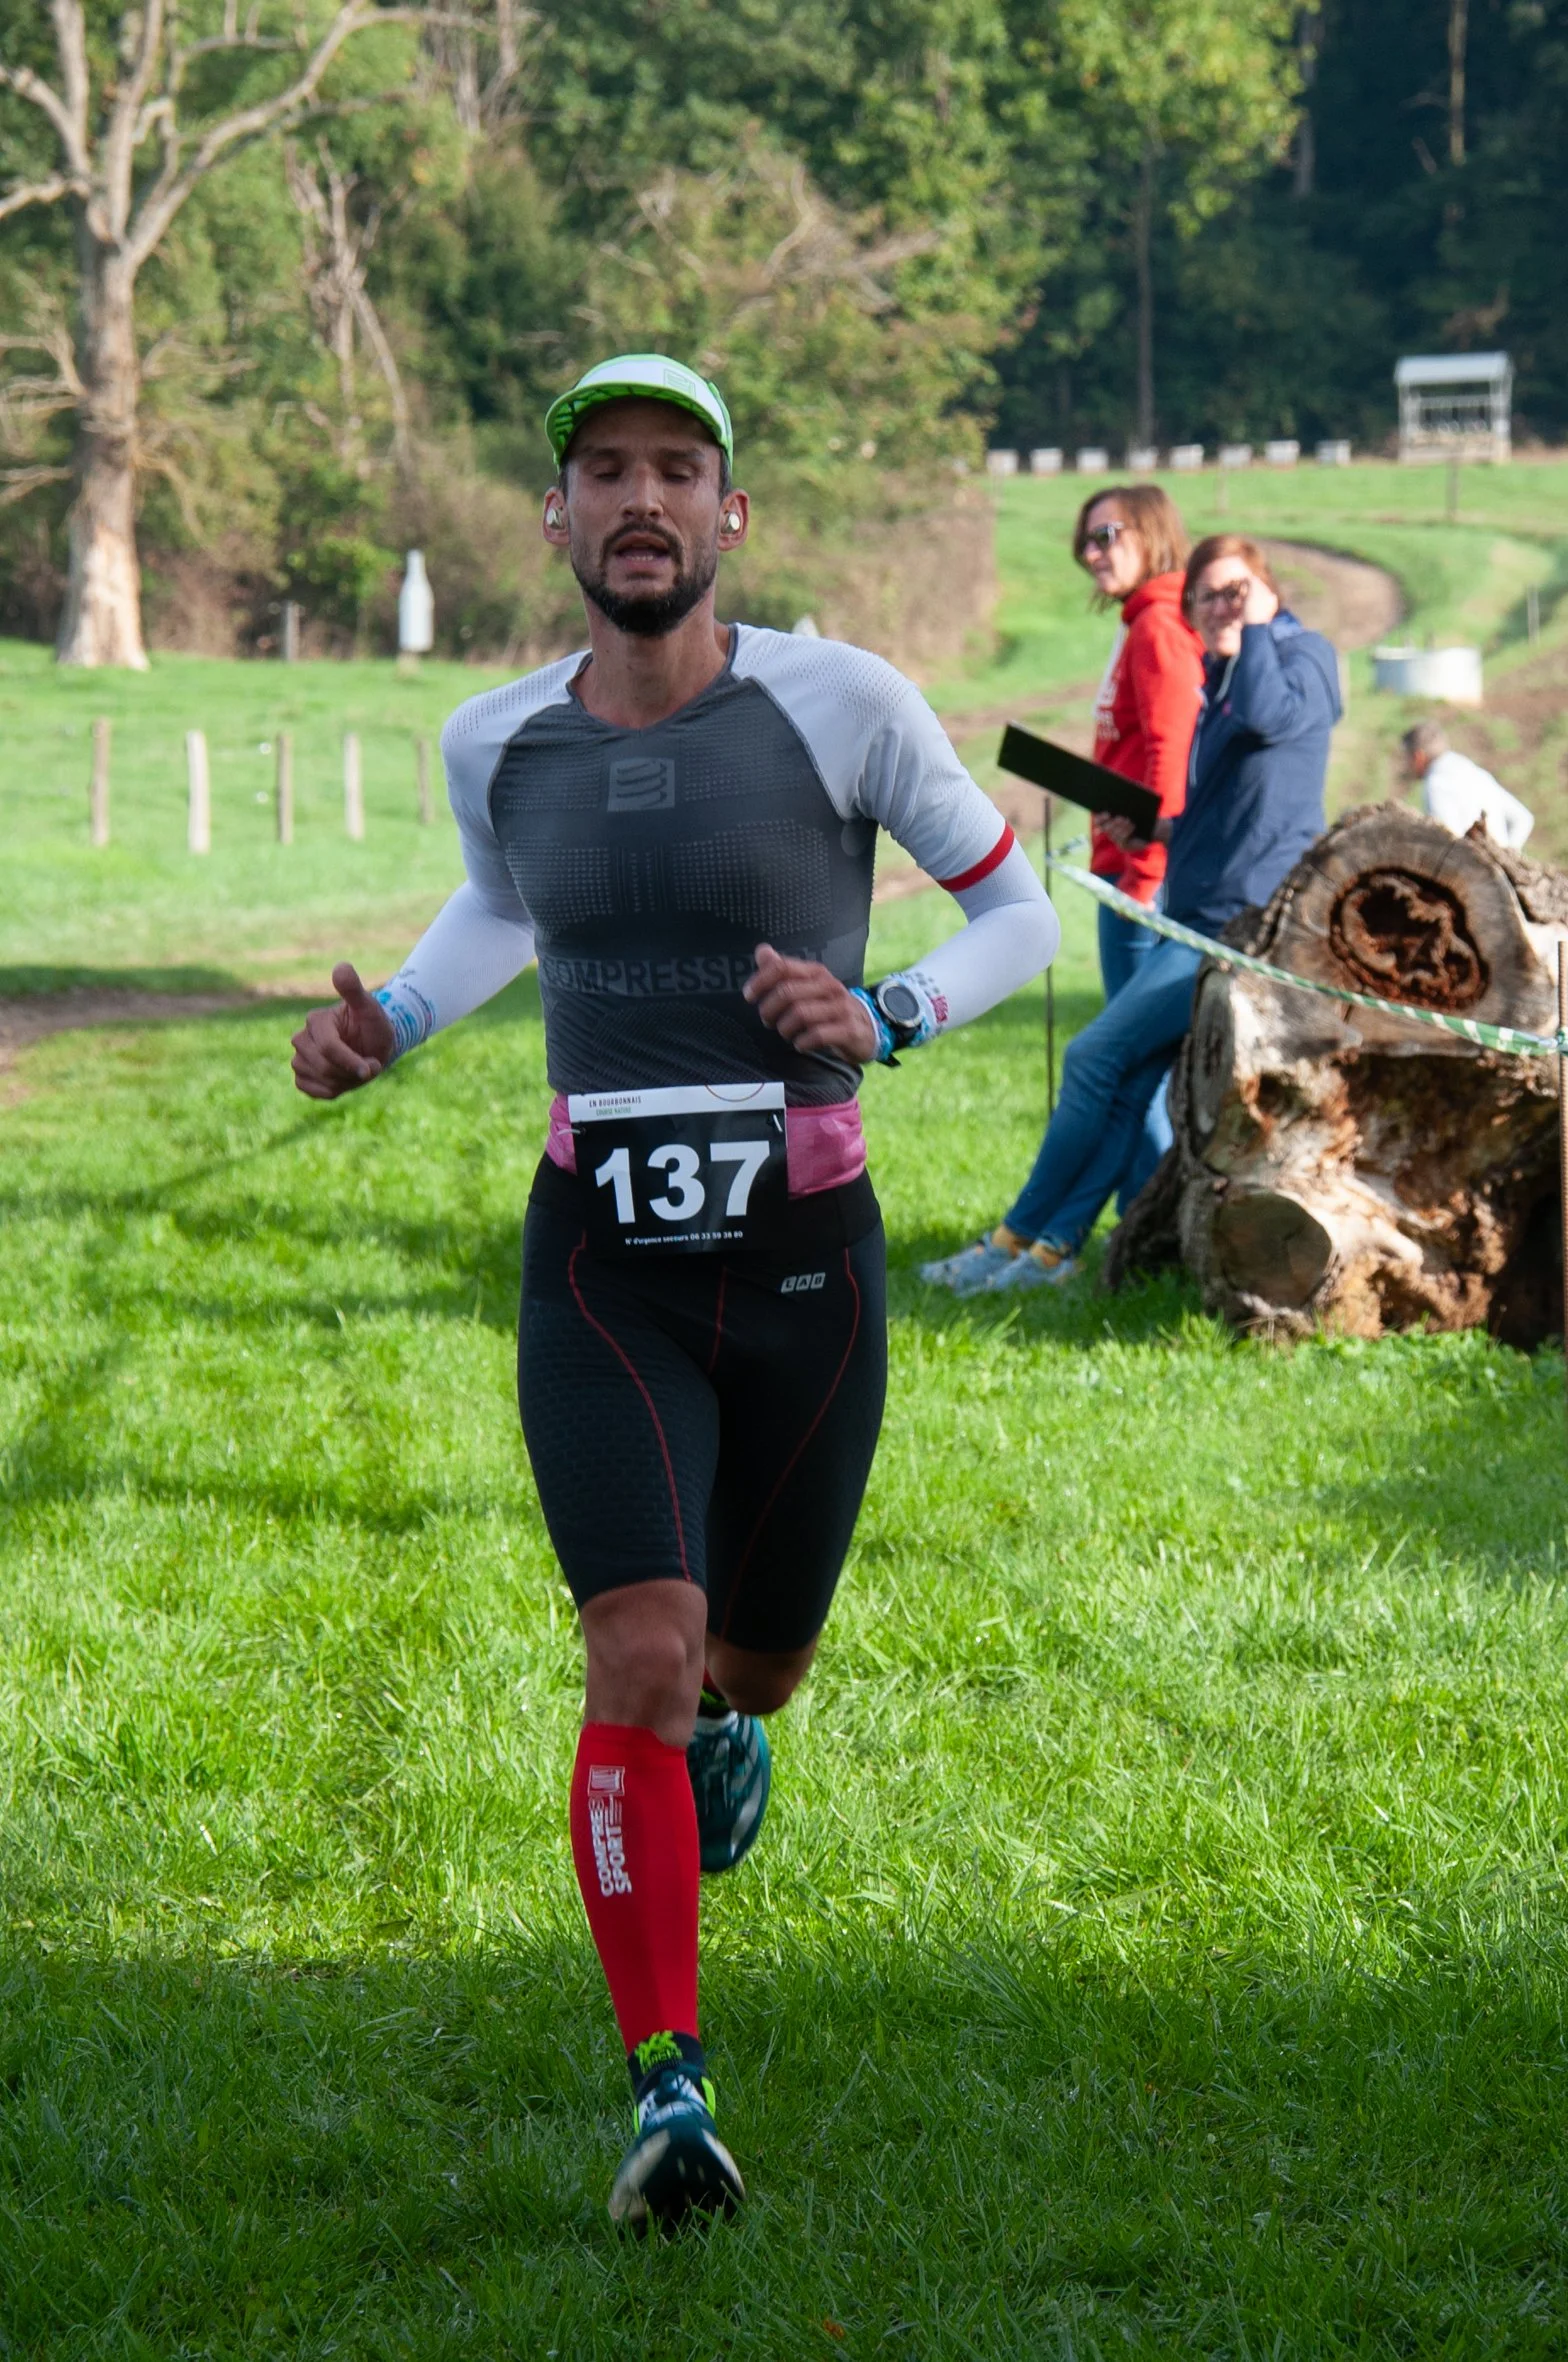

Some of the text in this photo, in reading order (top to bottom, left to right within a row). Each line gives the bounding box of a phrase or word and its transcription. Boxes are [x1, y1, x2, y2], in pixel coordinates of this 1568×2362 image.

[543, 945, 827, 993] COMPRESSP
[598, 1095, 642, 1107] BOURBONNAIS
[595, 1140, 770, 1224] 137
